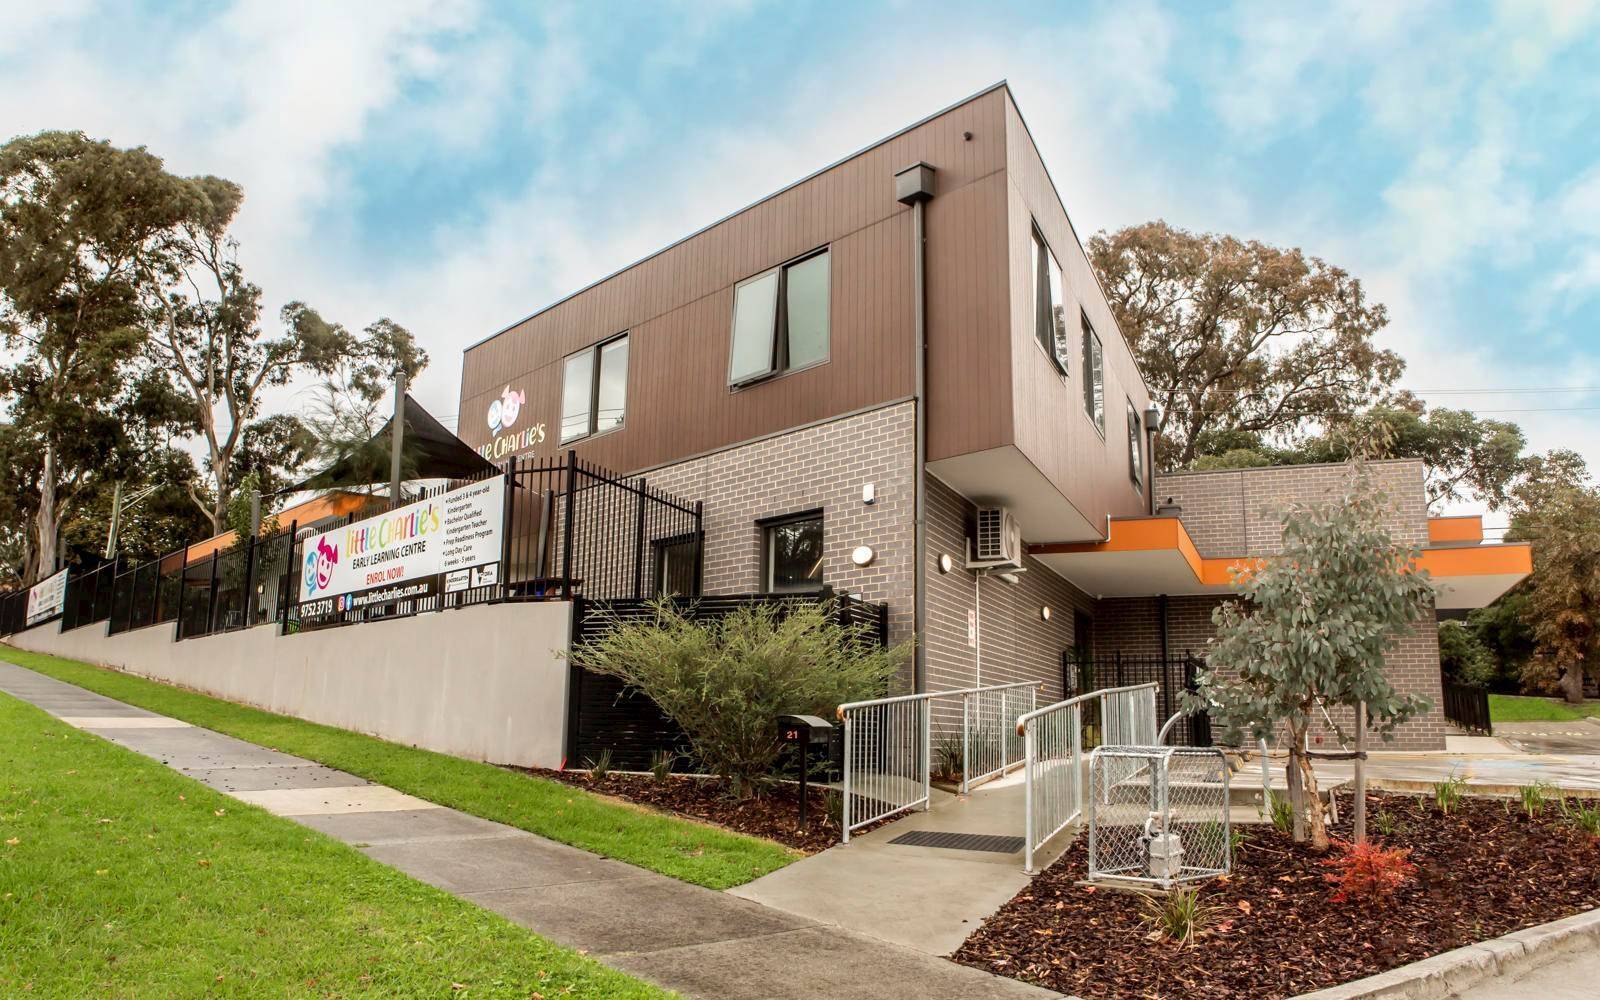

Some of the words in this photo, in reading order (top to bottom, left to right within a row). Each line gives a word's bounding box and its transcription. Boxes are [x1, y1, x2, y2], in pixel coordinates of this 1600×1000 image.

[449, 494, 462, 503] Funded
[472, 485, 490, 499] year-old
[447, 502, 473, 514] Kindergarten
[447, 515, 463, 524] Bachelor
[464, 508, 482, 520] Qualified
[446, 524, 471, 535] Kindergarten
[471, 519, 488, 528] Teacher
[446, 538, 455, 546] Prep
[455, 534, 475, 543] Readiness
[474, 529, 493, 539] Program
[352, 556, 371, 570] EARLY
[370, 547, 400, 565] LEARNING
[400, 541, 426, 558] CENTRE
[445, 549, 455, 557] Long
[463, 544, 473, 552] Care
[447, 558, 459, 566] weeks
[465, 555, 476, 564] years
[366, 571, 386, 585] ENROL
[387, 566, 405, 580] NOW!
[352, 583, 429, 606] www.littlecharlies.com.au
[300, 602, 317, 617] 9752
[317, 599, 333, 614] 3719
[786, 730, 798, 739] 21
